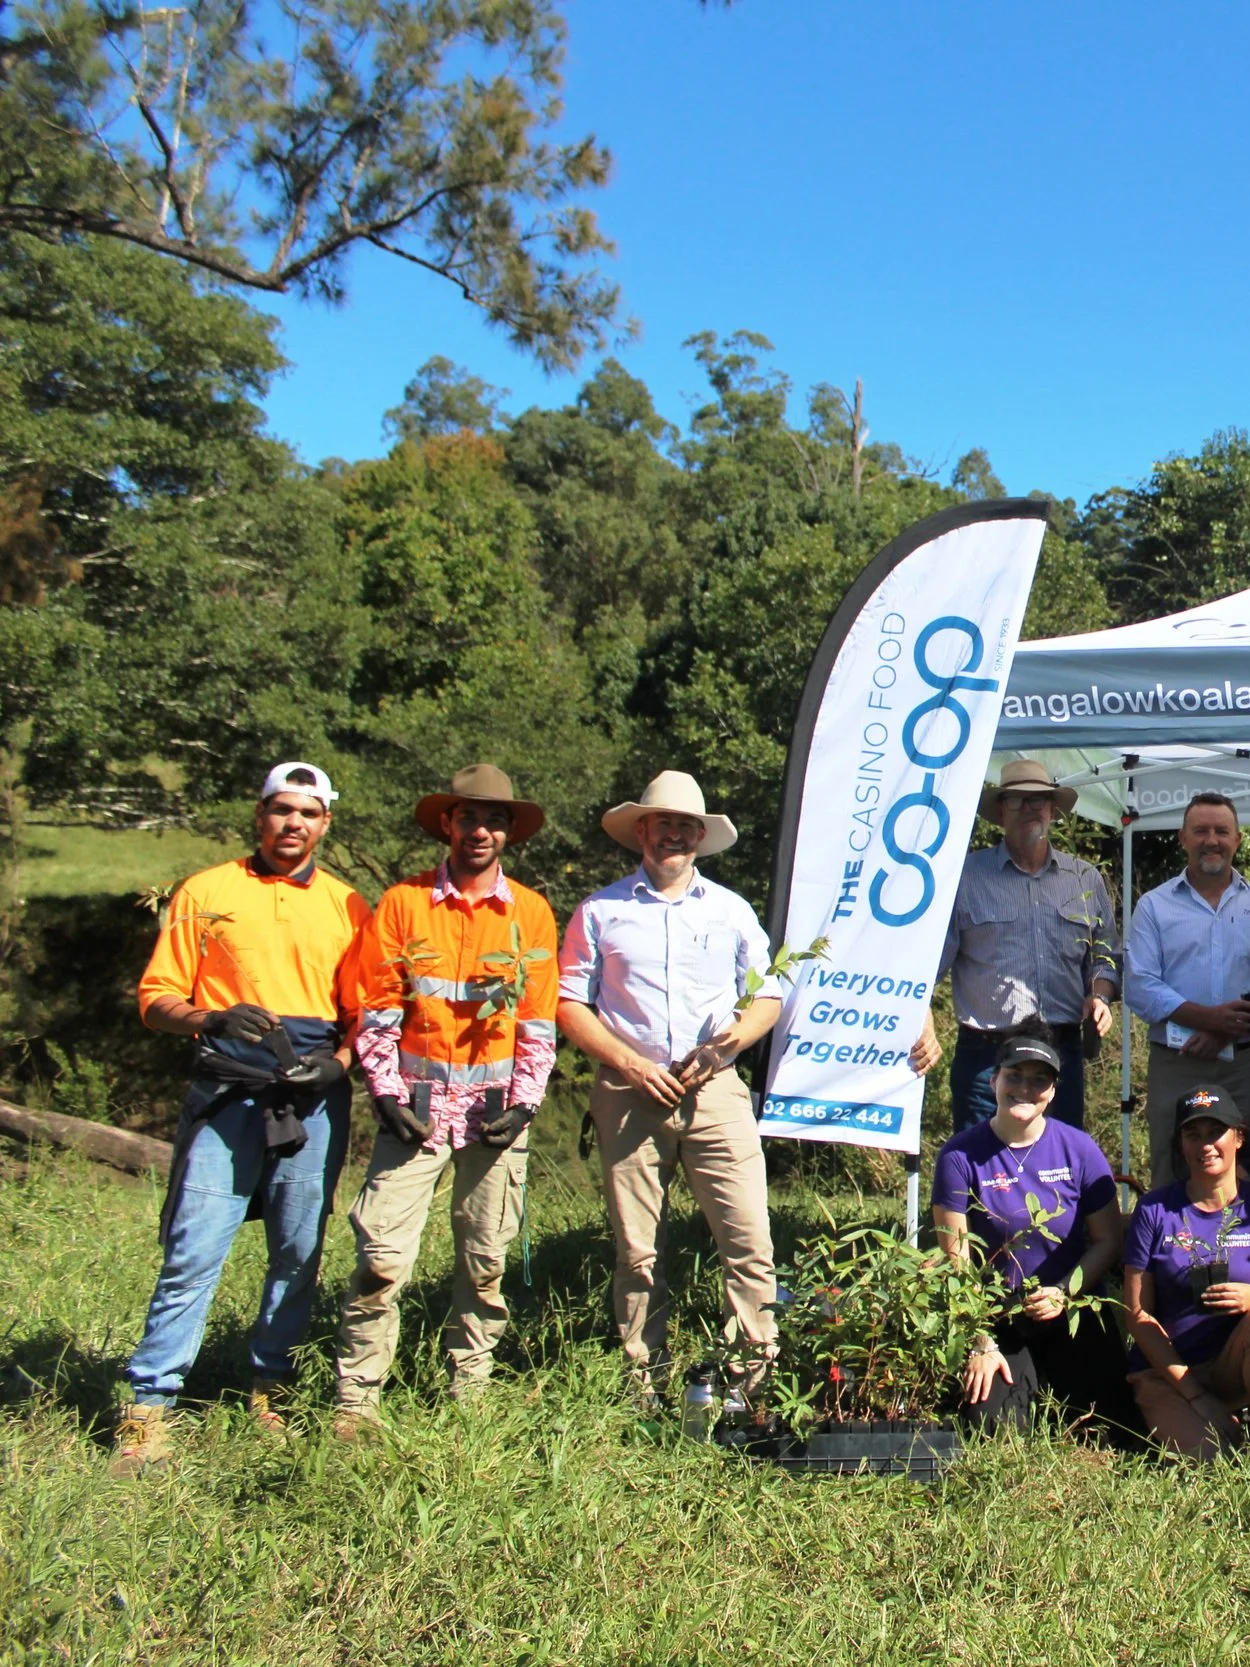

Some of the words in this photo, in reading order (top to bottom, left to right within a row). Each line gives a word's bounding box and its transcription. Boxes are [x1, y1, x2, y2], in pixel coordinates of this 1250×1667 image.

[994, 642, 1006, 671] SINCE
[831, 860, 863, 923] THE
[849, 722, 888, 852] CASINO
[869, 613, 905, 710] FOOD
[809, 1001, 900, 1032] Grows
[781, 1034, 908, 1067] Together
[763, 1100, 785, 1116] 02
[789, 1103, 827, 1119] 666
[831, 1107, 852, 1121] 22
[856, 1109, 893, 1127] 444
